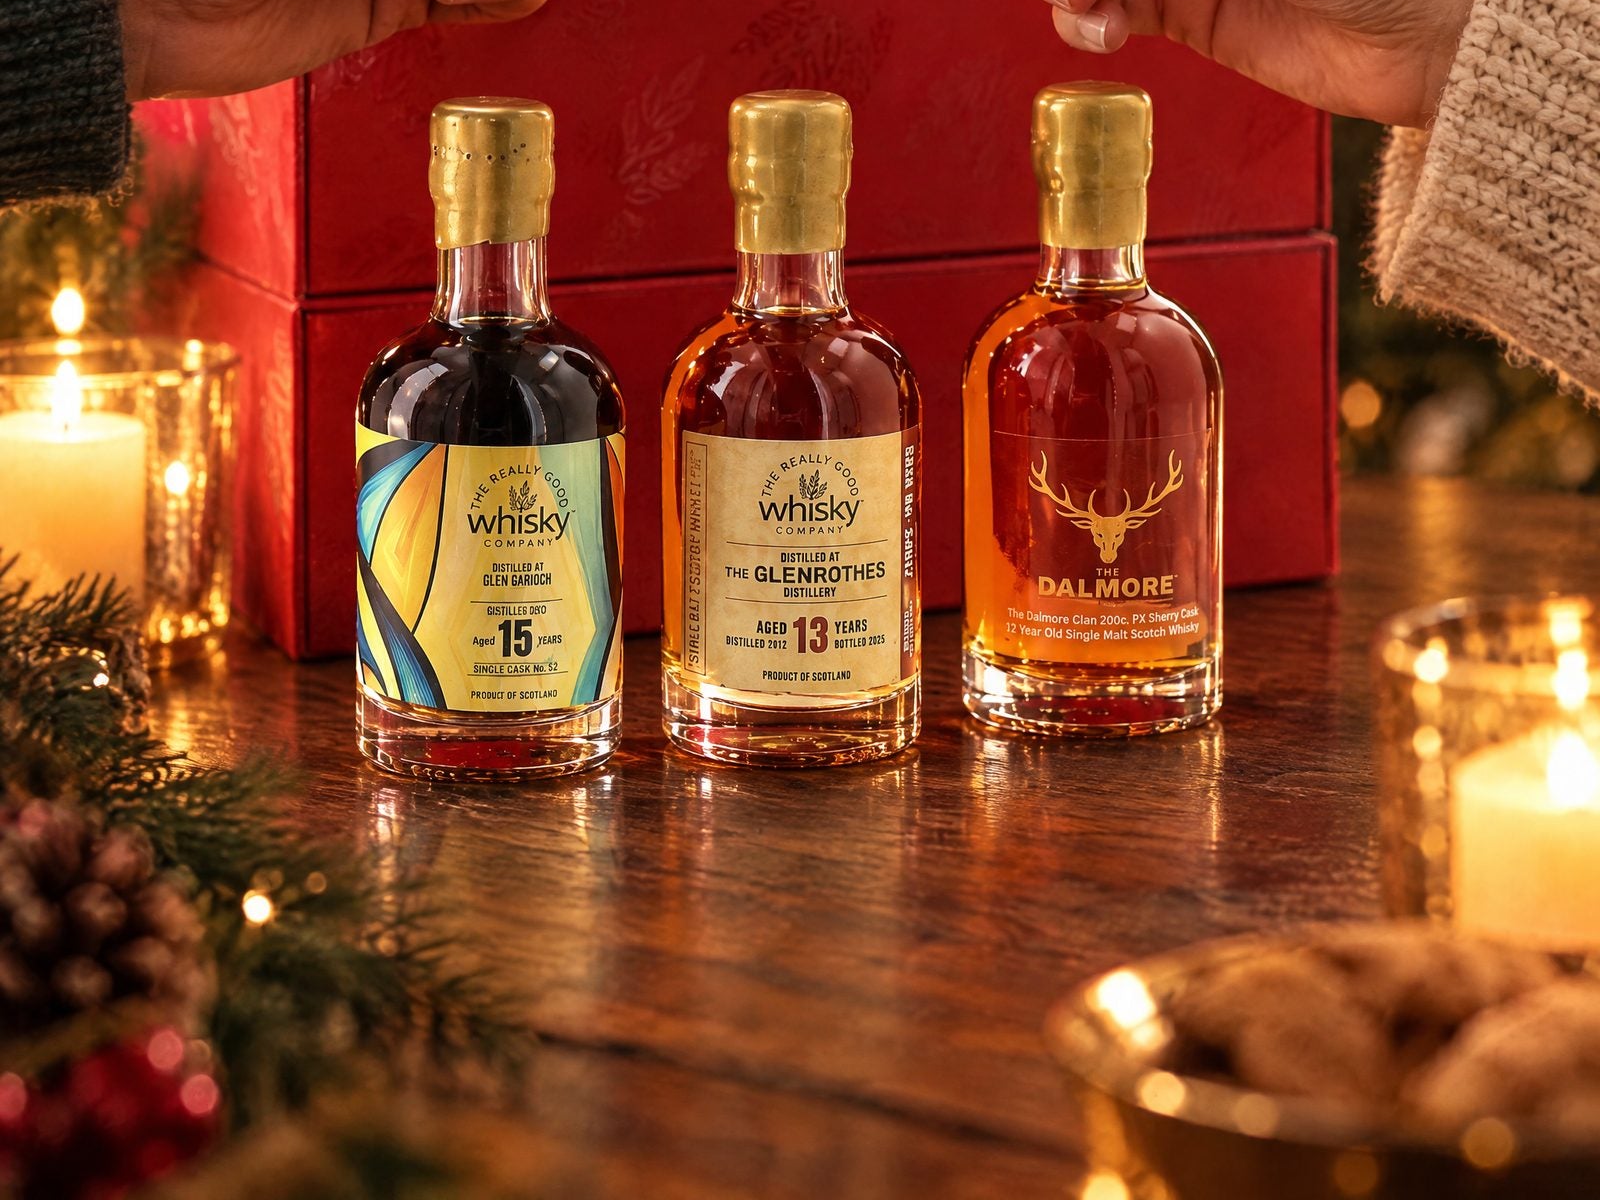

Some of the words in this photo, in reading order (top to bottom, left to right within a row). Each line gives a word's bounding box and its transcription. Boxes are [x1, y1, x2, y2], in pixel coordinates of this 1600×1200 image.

[761, 470, 780, 497] THE
[780, 453, 832, 472] REALLY
[834, 461, 859, 497] GOOD
[470, 483, 490, 511] THE
[489, 464, 541, 484] REALLY
[544, 471, 569, 508] GOOD
[758, 494, 861, 528] whisky
[467, 505, 570, 541] whisky
[775, 525, 843, 535] COMPANY
[484, 538, 553, 548] COMPANY
[780, 552, 826, 563] DISTILLED
[829, 551, 840, 562] AT
[492, 563, 532, 573] DISTILLED
[534, 562, 544, 573] AT
[725, 566, 749, 579] THE
[754, 561, 886, 584] GLENROTHES
[1096, 568, 1119, 577] THE
[483, 574, 508, 587] GLEN
[511, 573, 552, 587] GARIOCH
[1038, 574, 1174, 598] DALMORE
[783, 587, 837, 598] DISTILLERY
[1007, 607, 1025, 620] The
[1026, 610, 1069, 625] Dalmore
[1072, 614, 1097, 626] Clan
[1099, 614, 1129, 626] 200c.
[1132, 613, 1146, 624] PX
[1149, 609, 1179, 625] Sherry
[1180, 605, 1200, 619] Cask
[472, 636, 496, 648] Aged
[498, 618, 533, 657] 15
[537, 634, 562, 648] YEARS
[756, 620, 787, 635] AGED
[792, 616, 829, 654] 13
[834, 618, 867, 634] YEARS
[1006, 622, 1017, 633] 12
[1019, 625, 1042, 637] Year
[1044, 626, 1063, 639] Old
[1065, 628, 1100, 643] Single
[1103, 629, 1127, 641] Malt
[1130, 627, 1166, 640] Scotch
[1168, 622, 1200, 636] Whisky
[726, 635, 765, 649] DISTILLED
[768, 640, 787, 650] 2012
[834, 637, 866, 649] BOTTLED
[868, 634, 885, 646] 2025
[473, 664, 504, 674] SINGLE
[507, 664, 530, 674] CASK
[533, 663, 546, 673] No.
[762, 670, 798, 682] PRODUCT
[800, 672, 810, 682] OF
[812, 670, 851, 682] SCOTLAND
[470, 689, 504, 700] PRODUCT
[507, 690, 517, 700] OF
